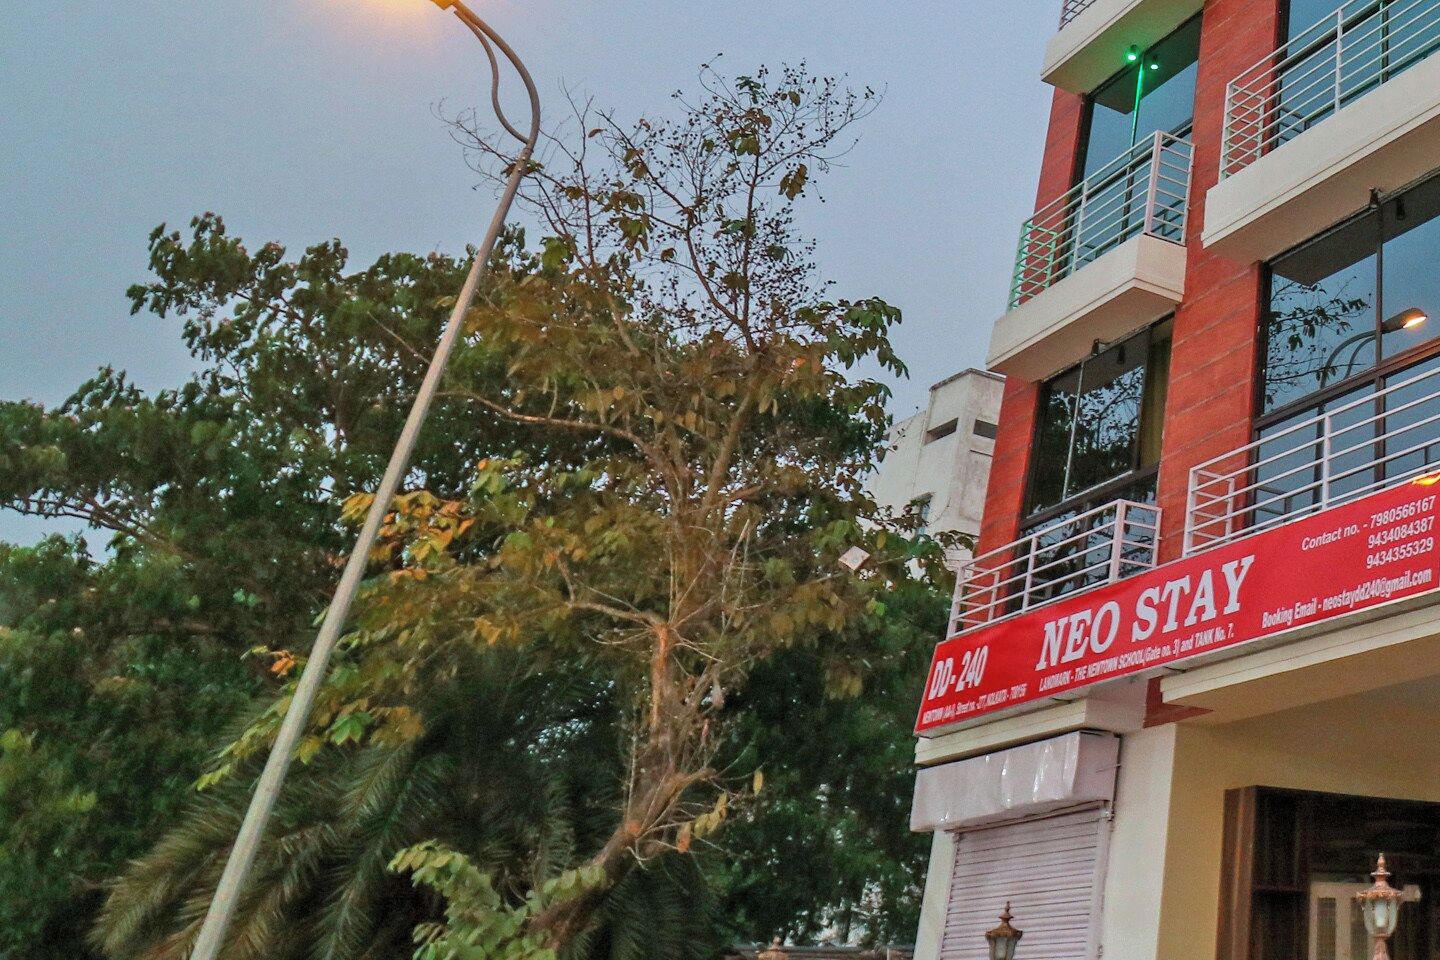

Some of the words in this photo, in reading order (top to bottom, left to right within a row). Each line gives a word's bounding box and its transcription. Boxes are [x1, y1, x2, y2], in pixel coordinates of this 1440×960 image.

[1302, 527, 1341, 551] Contact
[1343, 523, 1360, 538] no.
[1370, 495, 1436, 529] 7980566167
[1368, 516, 1435, 549] 9434084387
[1366, 536, 1434, 569] 9434355329
[1035, 600, 1121, 671] NEO
[1131, 555, 1255, 642] STAY
[1262, 606, 1293, 629] Booking
[1295, 598, 1317, 620] Email
[1323, 568, 1432, 611] neostaydd240@gmail.com
[1039, 671, 1072, 692] LANDMARK
[1075, 665, 1088, 682] THE
[1087, 656, 1118, 678] NEWTOWN
[1161, 644, 1171, 657] no.
[1180, 634, 1194, 652] and
[1195, 628, 1215, 648] TANK
[1214, 626, 1226, 642] No.
